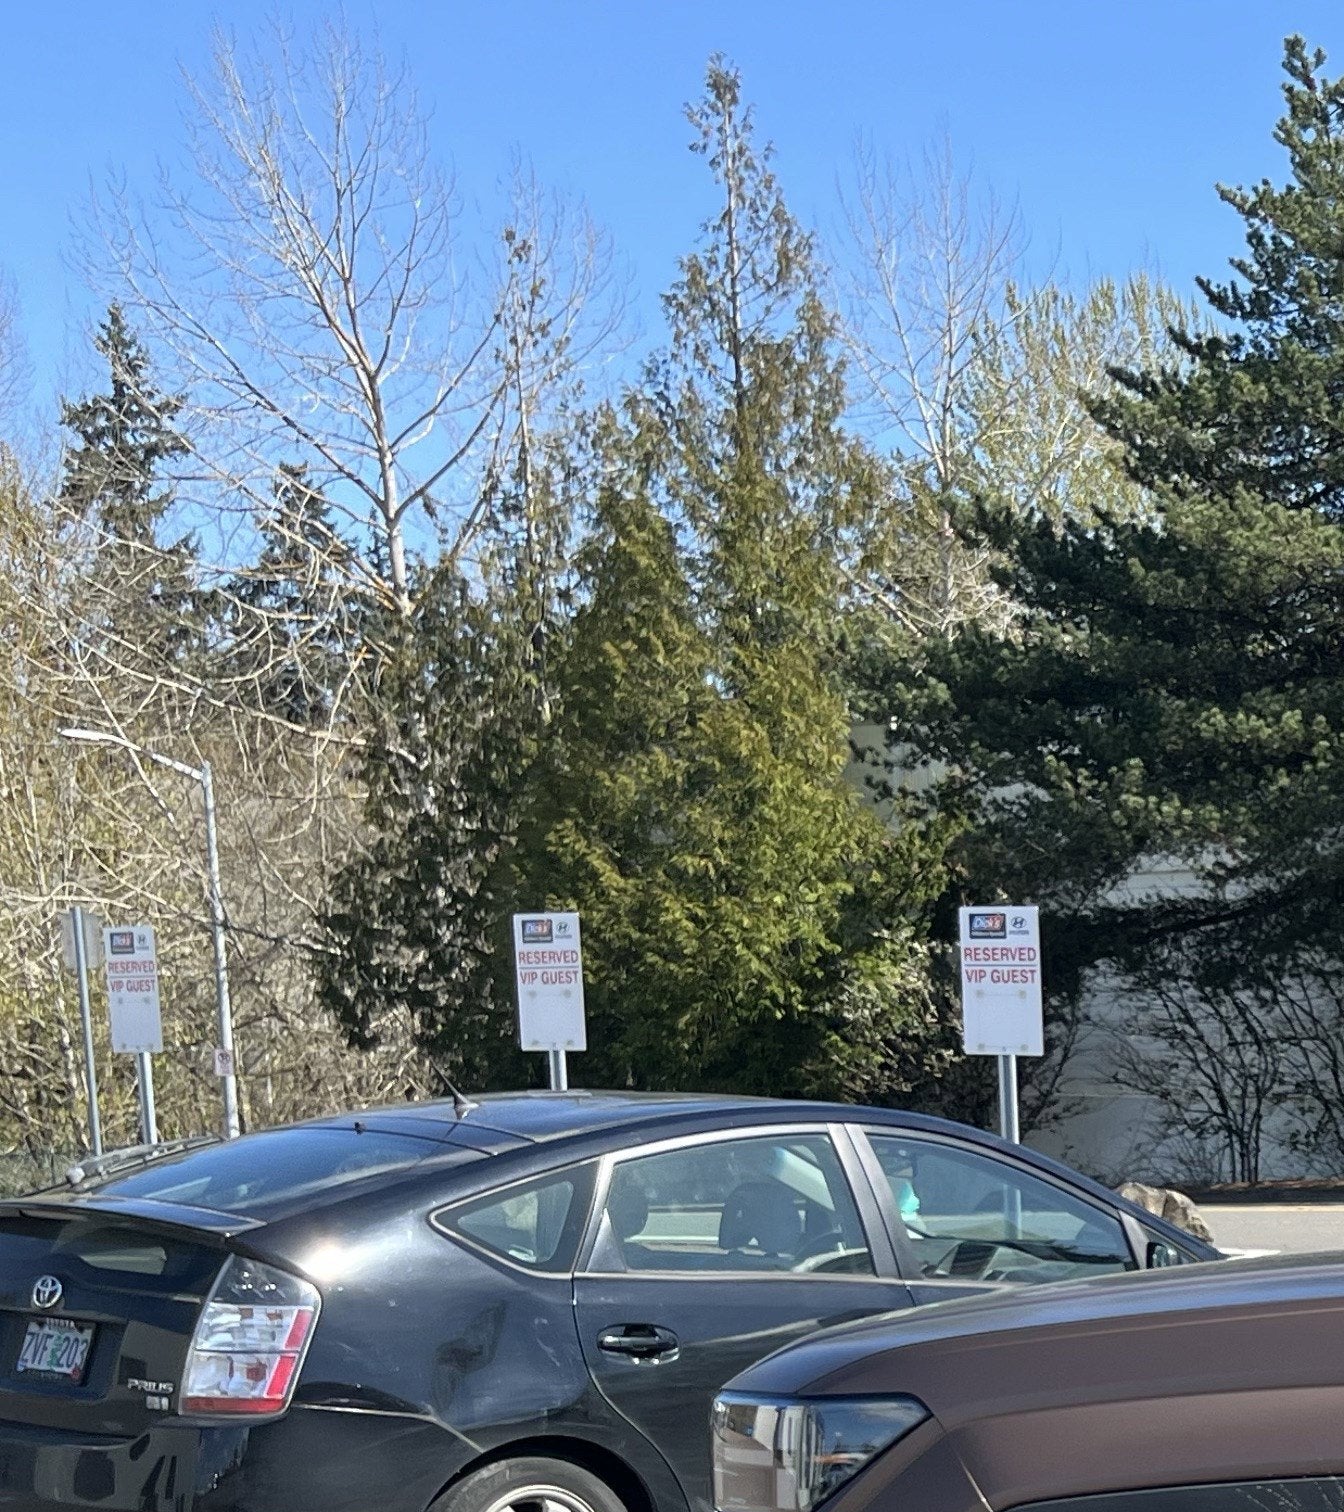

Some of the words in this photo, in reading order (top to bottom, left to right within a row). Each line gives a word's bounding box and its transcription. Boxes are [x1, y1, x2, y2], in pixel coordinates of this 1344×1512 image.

[518, 950, 579, 965] RESERVED
[963, 947, 1037, 962] RESERVED
[108, 960, 155, 974] RESERVED
[519, 971, 538, 985] VIP
[541, 970, 579, 985] GUEST
[965, 969, 987, 983] VIP
[990, 969, 1037, 984] GUEST
[109, 980, 124, 992] VIP
[126, 979, 155, 992] GUEST
